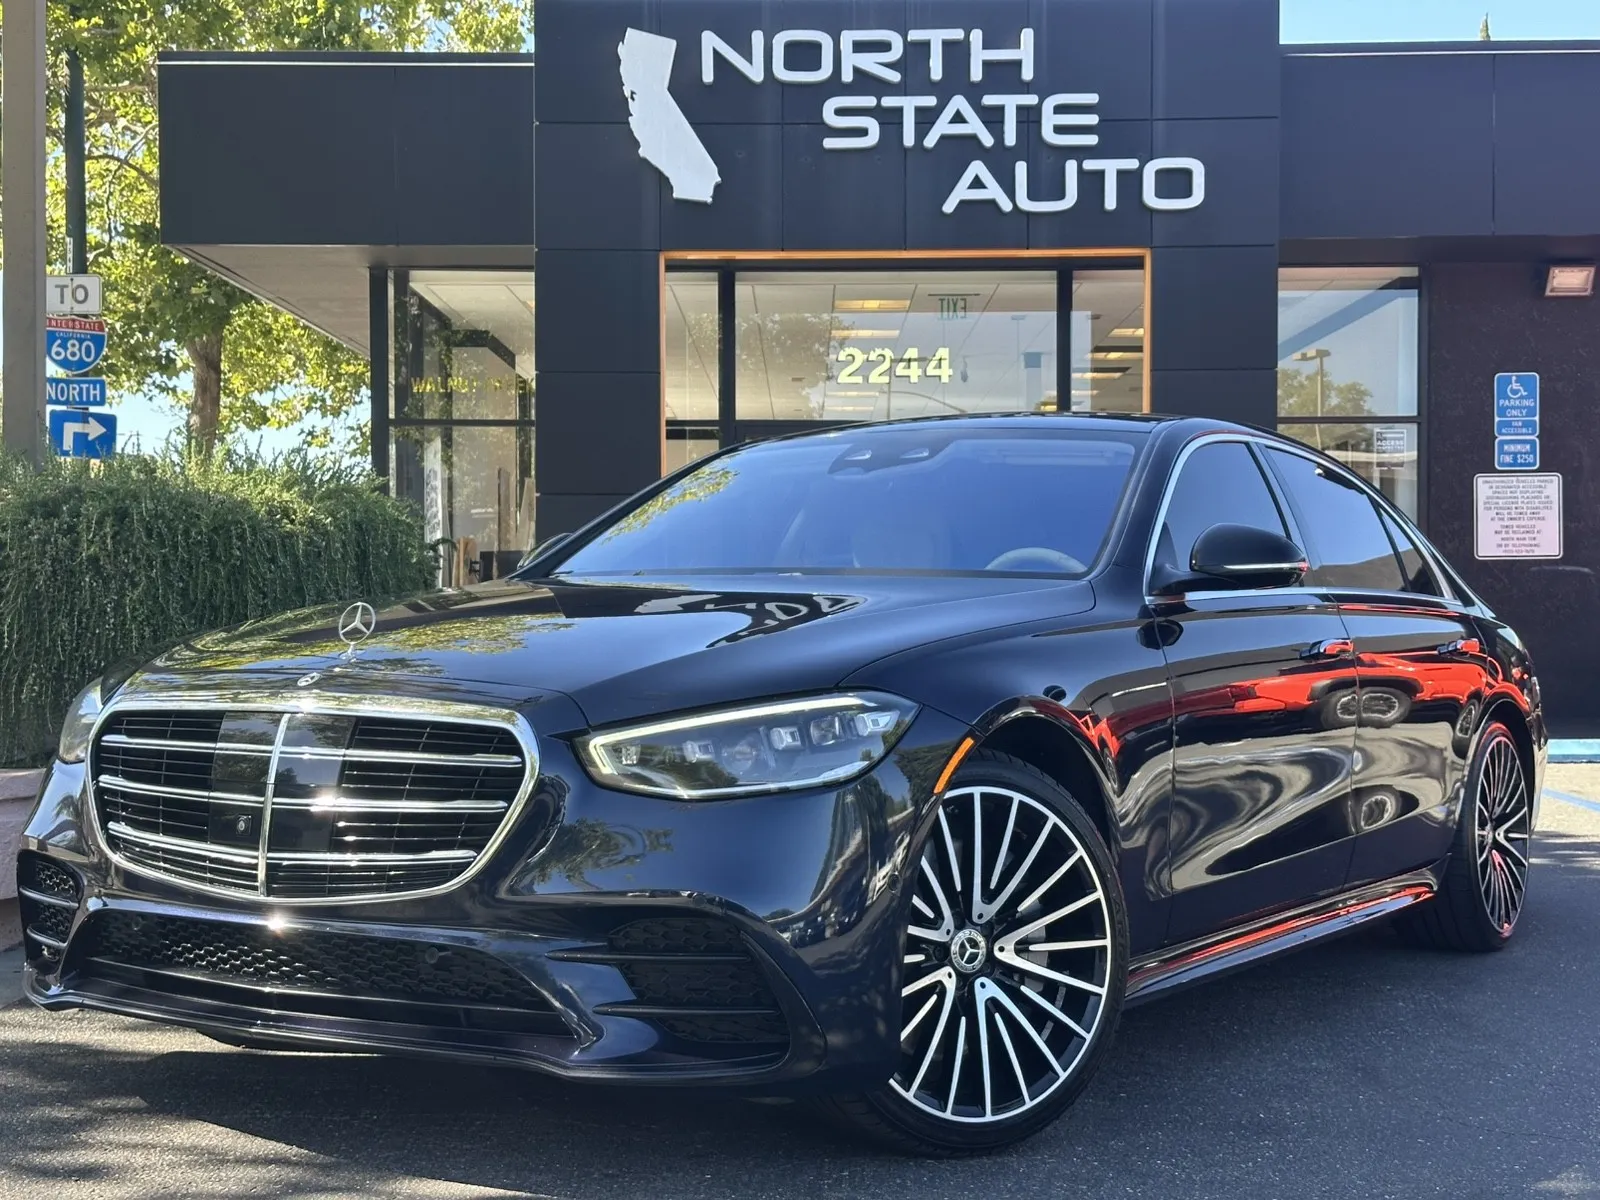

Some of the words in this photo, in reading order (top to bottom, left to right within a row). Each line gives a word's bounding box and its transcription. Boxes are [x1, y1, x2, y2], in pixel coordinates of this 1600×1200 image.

[701, 27, 1034, 85] NORTH
[822, 92, 1100, 150] STATE
[941, 156, 1206, 214] AUTO
[54, 284, 89, 305] TO
[46, 319, 100, 331] INTERSTATE
[56, 331, 91, 339] CALIFORNIA
[51, 338, 95, 362] 680
[836, 346, 953, 385] 2244
[46, 382, 100, 402] NORTH
[1499, 398, 1535, 407] PARKING
[1506, 409, 1527, 417] ONLY
[1503, 443, 1531, 453] MINIMUM
[1500, 454, 1513, 464] FINE
[1516, 454, 1534, 463] $250
